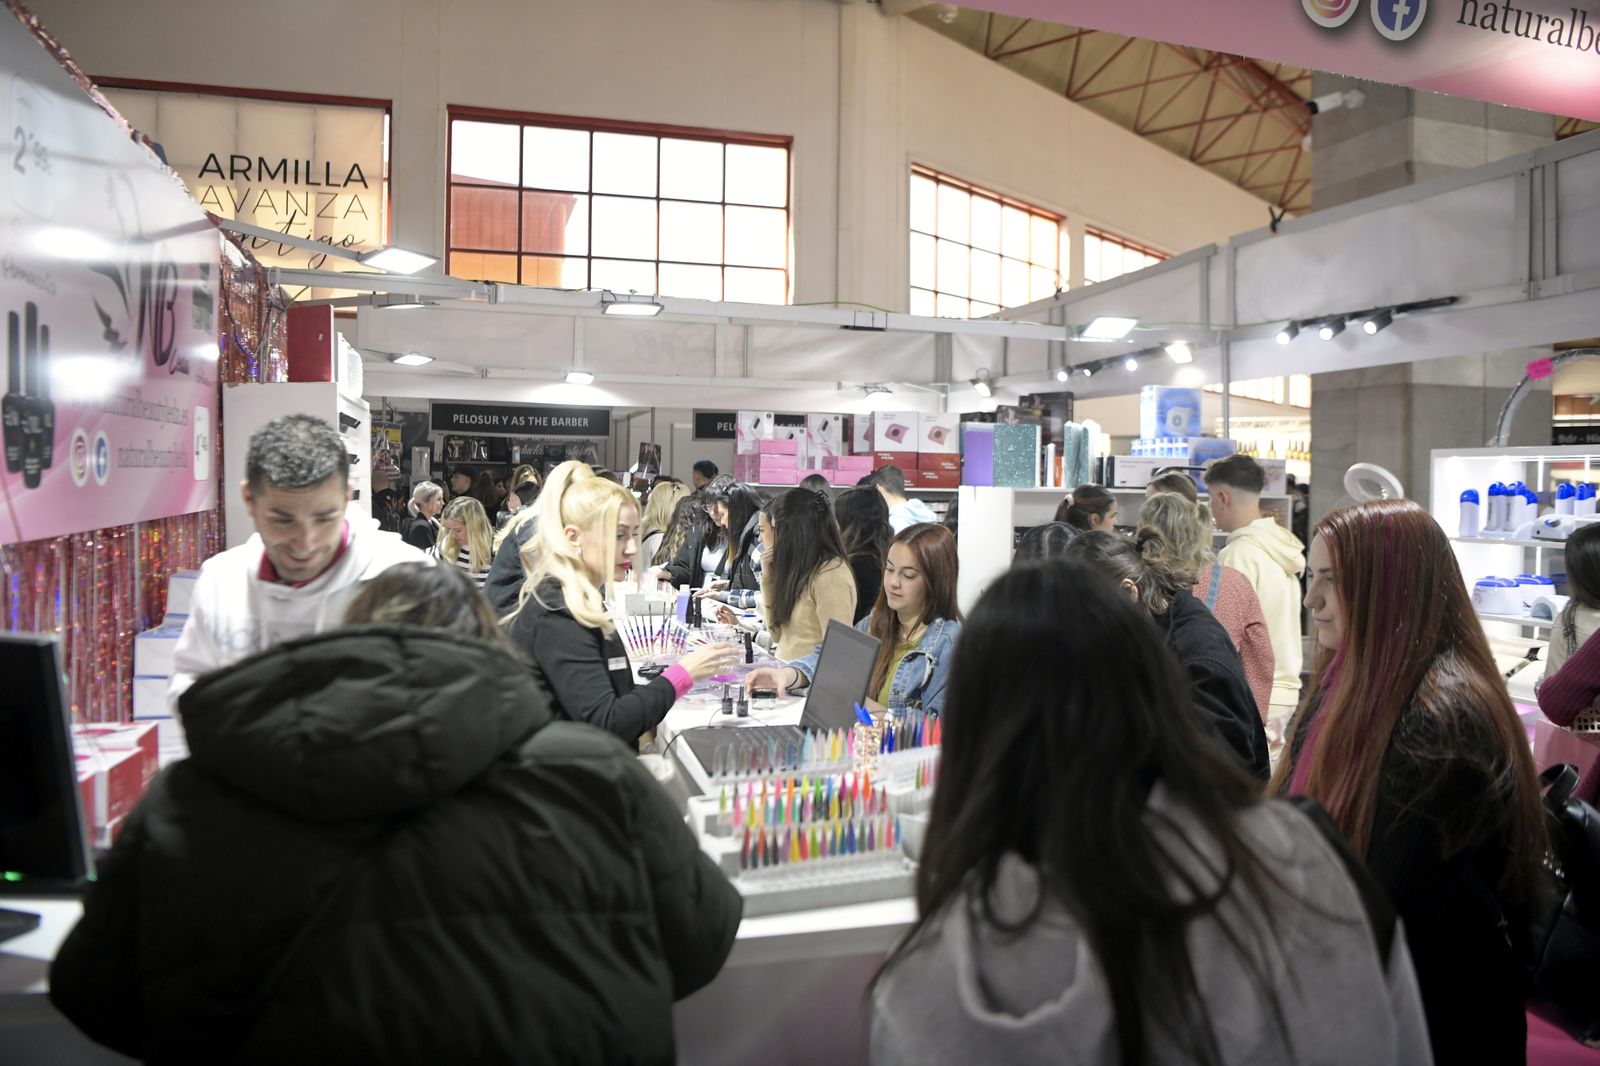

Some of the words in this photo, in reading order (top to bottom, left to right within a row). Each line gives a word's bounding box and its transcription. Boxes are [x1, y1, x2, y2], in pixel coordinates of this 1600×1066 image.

[197, 153, 369, 190] ARMILLA
[199, 184, 369, 221] AVANZA
[453, 413, 499, 426] PELOSUR
[501, 415, 509, 426] Y
[510, 416, 525, 427] AS
[528, 416, 548, 427] THE
[551, 416, 589, 428] BARBER
